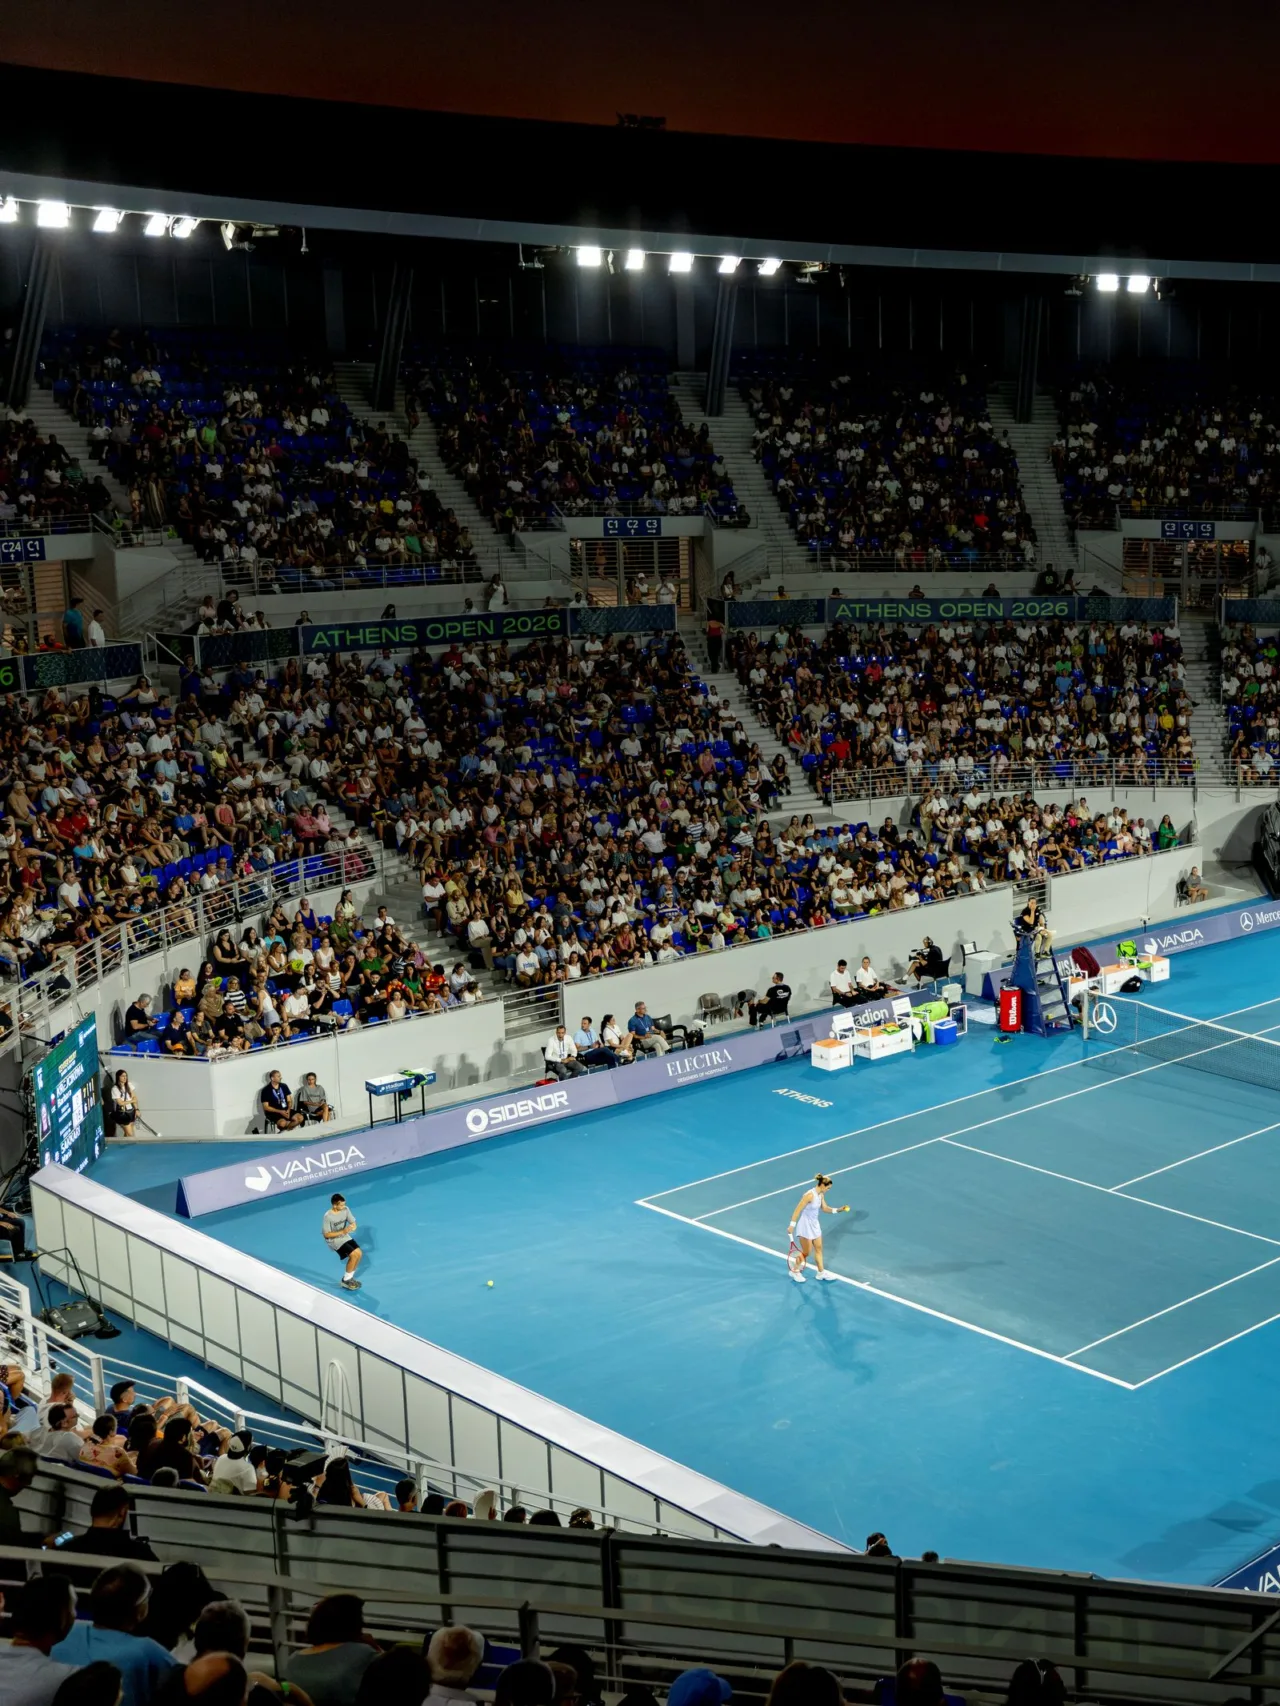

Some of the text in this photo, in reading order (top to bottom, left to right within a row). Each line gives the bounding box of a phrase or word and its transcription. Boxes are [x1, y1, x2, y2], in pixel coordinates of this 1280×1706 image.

[607, 519, 658, 529] C1 C2 C3
[1164, 523, 1212, 532] C3 C4 C5
[1, 540, 40, 553] C24 C1
[835, 602, 1068, 618] ATHENS OPEN 2026
[312, 614, 560, 649] ATHENS OPEN 2026
[1156, 928, 1204, 948] VANDA
[854, 1008, 889, 1026] adion
[1008, 996, 1018, 1026] Wilson
[666, 1048, 733, 1076] ELECTRA
[488, 1090, 570, 1124] SIDENOR
[772, 1088, 834, 1108] ATHENS
[271, 1145, 366, 1180] VANDA
[283, 1164, 353, 1187] PHARMACEUTICALS
